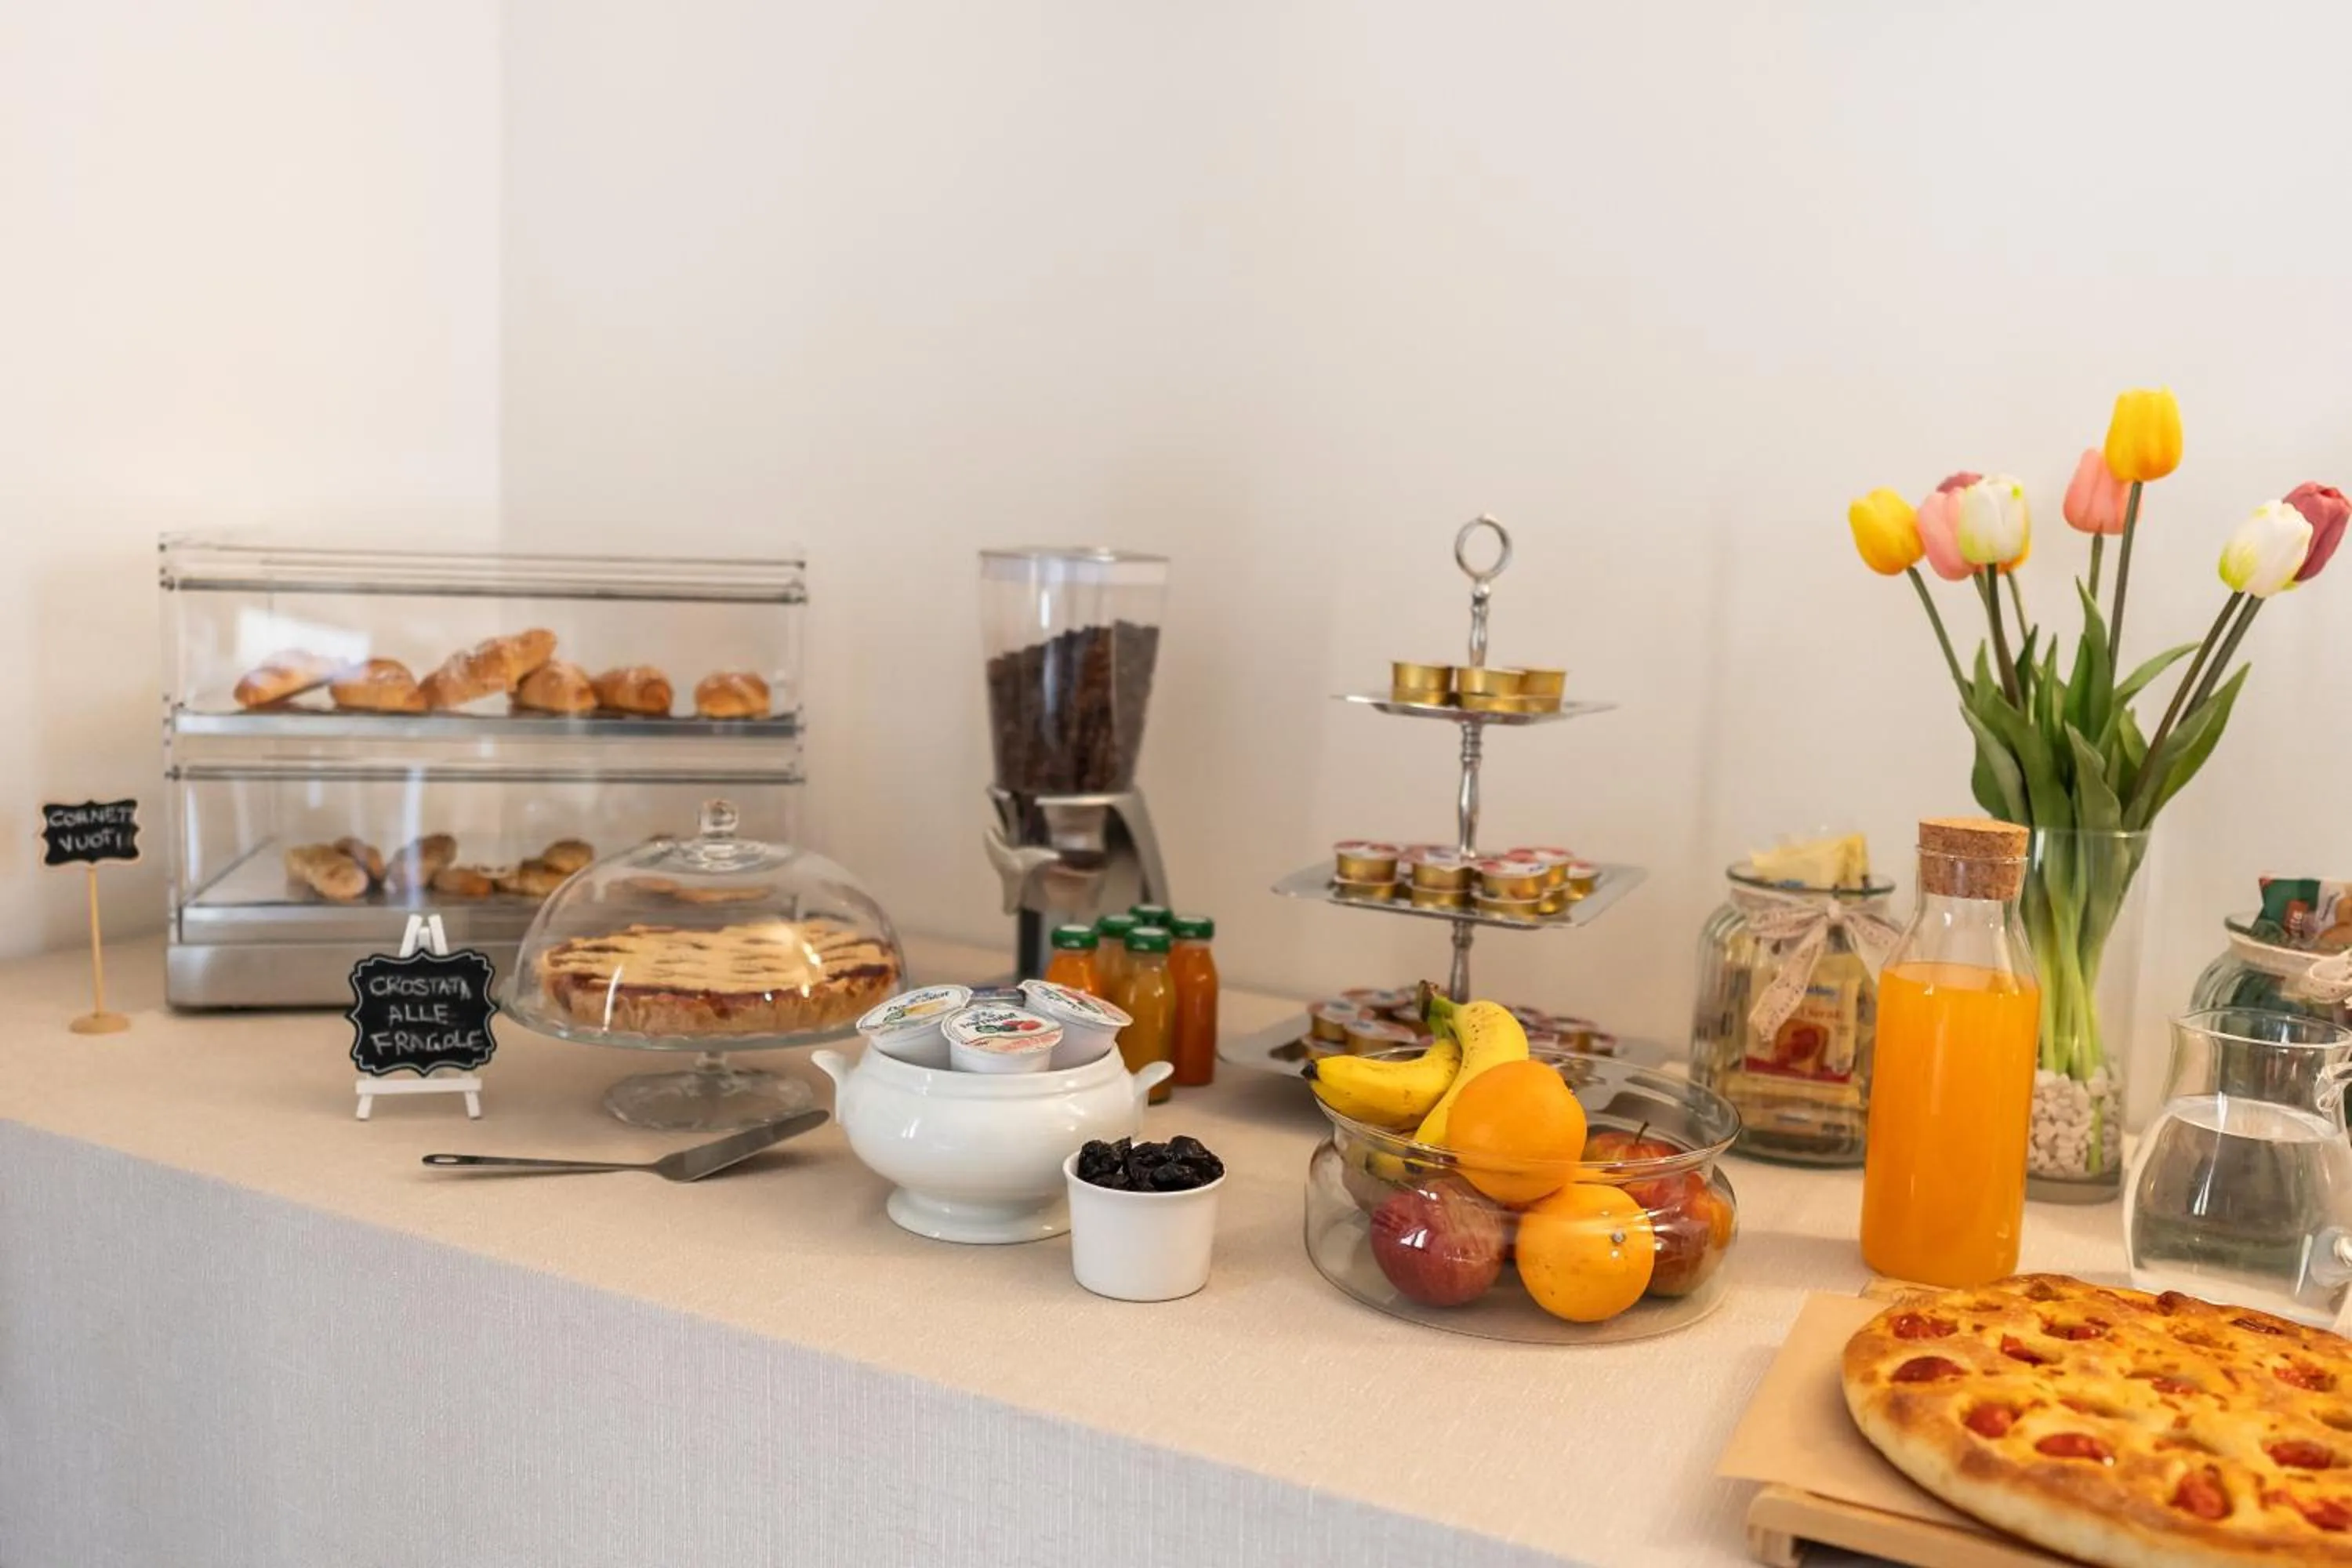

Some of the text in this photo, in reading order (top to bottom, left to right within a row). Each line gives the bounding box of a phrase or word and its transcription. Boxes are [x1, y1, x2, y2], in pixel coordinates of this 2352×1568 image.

[58, 828, 122, 852] VUOTI
[369, 976, 472, 1000] CROSTATA
[388, 1003, 448, 1025] ALLE
[369, 1029, 485, 1056] FRAGOLE
